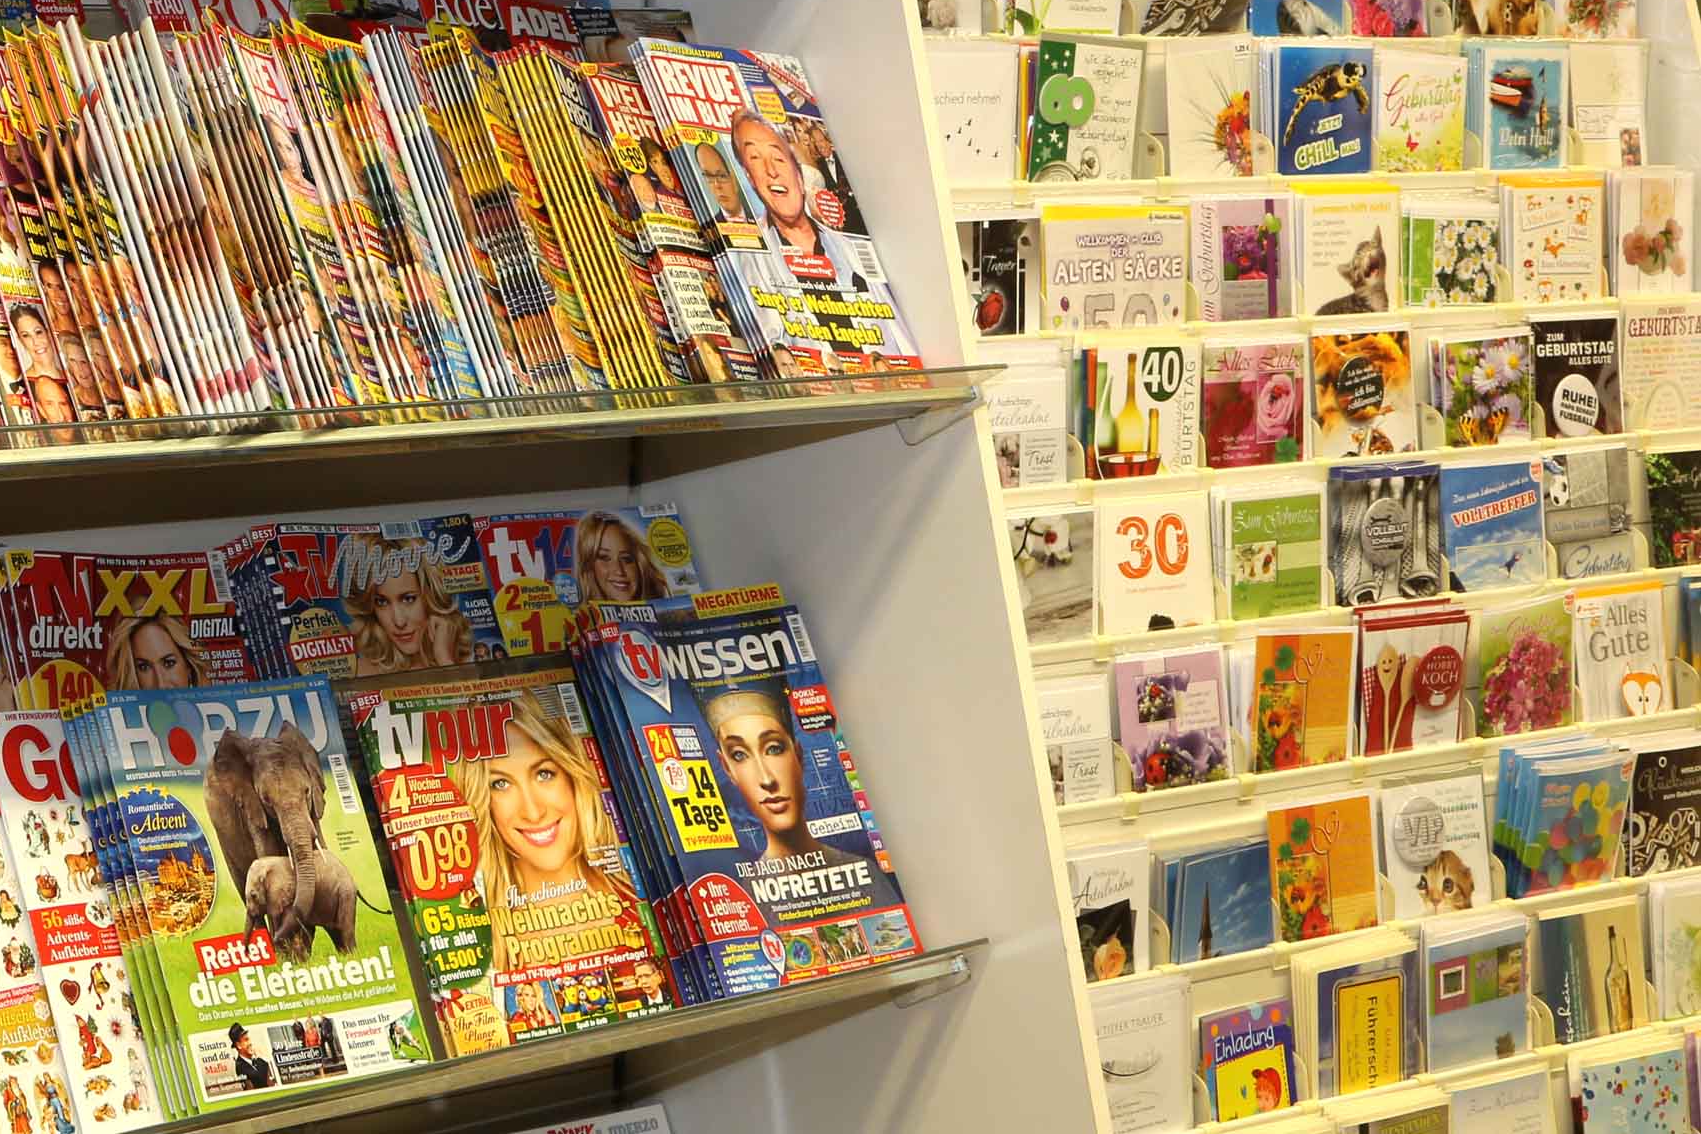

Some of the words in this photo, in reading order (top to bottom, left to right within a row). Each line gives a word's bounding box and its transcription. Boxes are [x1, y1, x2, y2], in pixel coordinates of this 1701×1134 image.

[661, 61, 740, 105] REVUE
[1055, 257, 1115, 284] ALTEN
[1123, 256, 1182, 280] SÄCKE
[1537, 341, 1614, 357] GEBURTSTAG
[1547, 332, 1563, 342] ZUM
[1142, 350, 1183, 393] 40
[1569, 357, 1592, 365] ALLES
[1594, 356, 1611, 364] GUTE
[1562, 388, 1597, 404] RUHE!
[1451, 491, 1536, 528] VOLLTREFFER
[1116, 512, 1190, 581] 30
[696, 586, 780, 611] MEGATÜRME
[1604, 605, 1647, 628] Alles
[30, 618, 103, 650] direkt
[1588, 627, 1650, 663] Gute
[1421, 669, 1460, 686] KOCH
[695, 766, 715, 798] 14
[132, 813, 188, 834] Advent
[673, 797, 726, 826] Tage
[810, 817, 858, 837] Geheim!
[751, 861, 872, 902] NOFRETETE
[423, 905, 453, 933] 65
[456, 914, 490, 928] Rätsel
[494, 890, 631, 934] Weihnachts-
[51, 944, 99, 961] Aufkleber
[200, 939, 271, 966] Rettet
[509, 927, 623, 967] Programm
[189, 975, 237, 1008] die
[241, 945, 395, 1000] Elefanten!
[439, 967, 482, 983] gewinnen
[1213, 1025, 1275, 1063] Einladung
